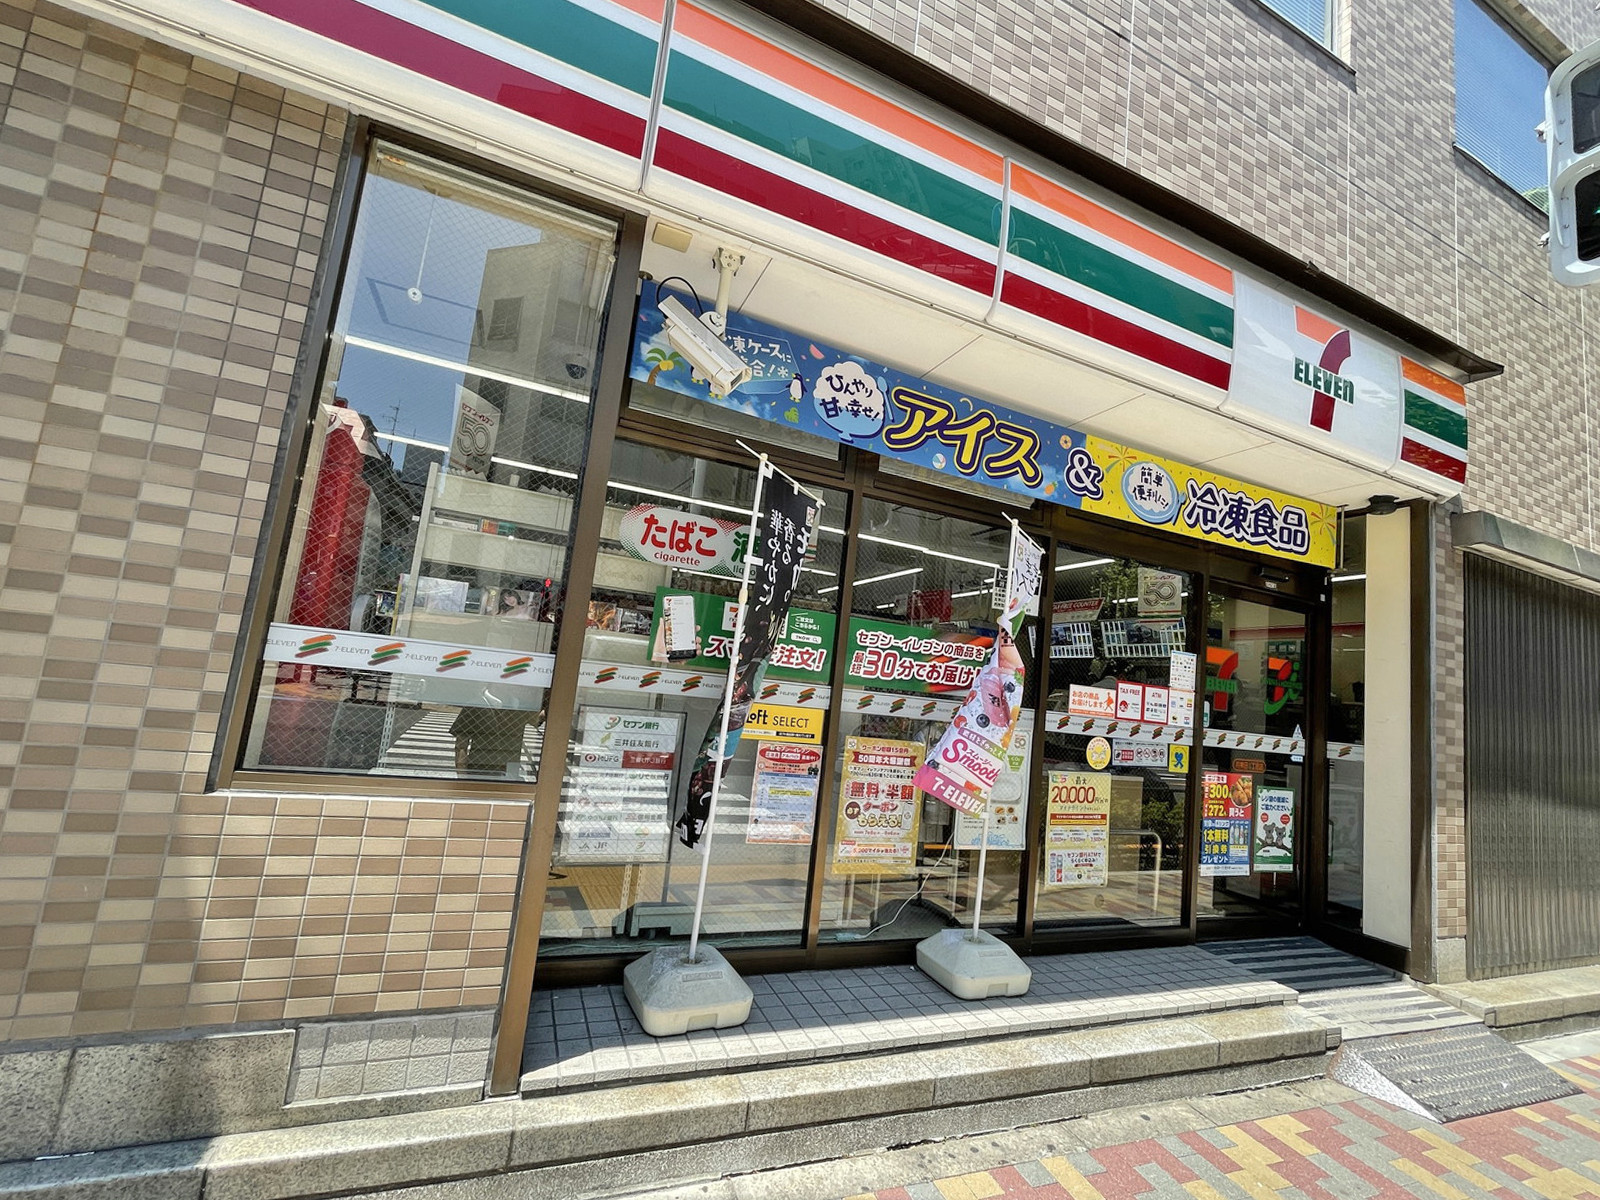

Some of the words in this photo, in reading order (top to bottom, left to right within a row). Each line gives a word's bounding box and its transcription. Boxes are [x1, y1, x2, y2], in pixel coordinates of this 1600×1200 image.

[723, 335, 792, 363] 凍ケースに
[1294, 306, 1351, 432] 7
[825, 374, 873, 398] ひんやり
[819, 396, 880, 421] 甘い幸せ!
[884, 387, 1041, 488] アイス
[1064, 448, 1103, 500] &
[1183, 478, 1310, 555] 冷凍食品
[1140, 466, 1164, 487] 簡単
[640, 514, 718, 558] たばこ
[653, 552, 701, 567] cigarette
[857, 630, 985, 660] セブン-イレブンの商品を
[623, 719, 660, 730] セブン銀行
[773, 715, 809, 728] SELECT
[614, 738, 660, 749] 三井住友銀行
[966, 748, 993, 767] スムージー
[863, 801, 898, 813] クーポン
[857, 813, 902, 828] もらえる!
[1203, 829, 1229, 843] 1本無料
[1202, 855, 1228, 864] プレゼント
